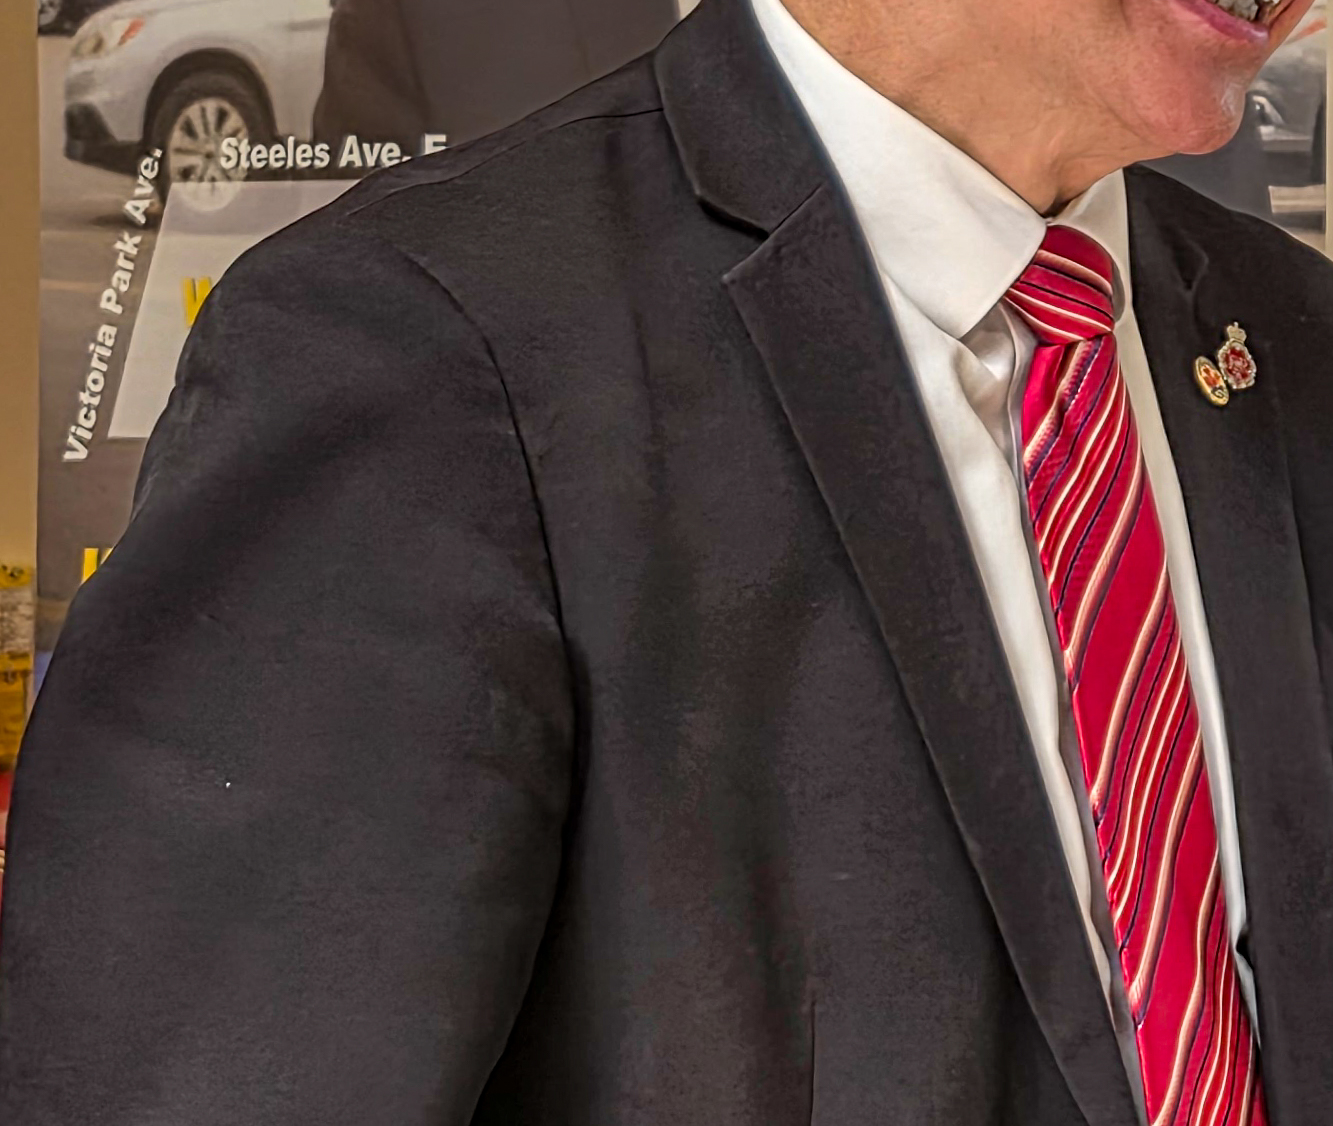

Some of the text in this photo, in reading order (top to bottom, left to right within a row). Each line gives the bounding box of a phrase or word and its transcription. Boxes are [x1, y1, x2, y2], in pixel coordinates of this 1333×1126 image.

[220, 135, 330, 170] Steeles
[339, 134, 413, 169] Ave.
[62, 147, 164, 462] Victoria Park Ave.
